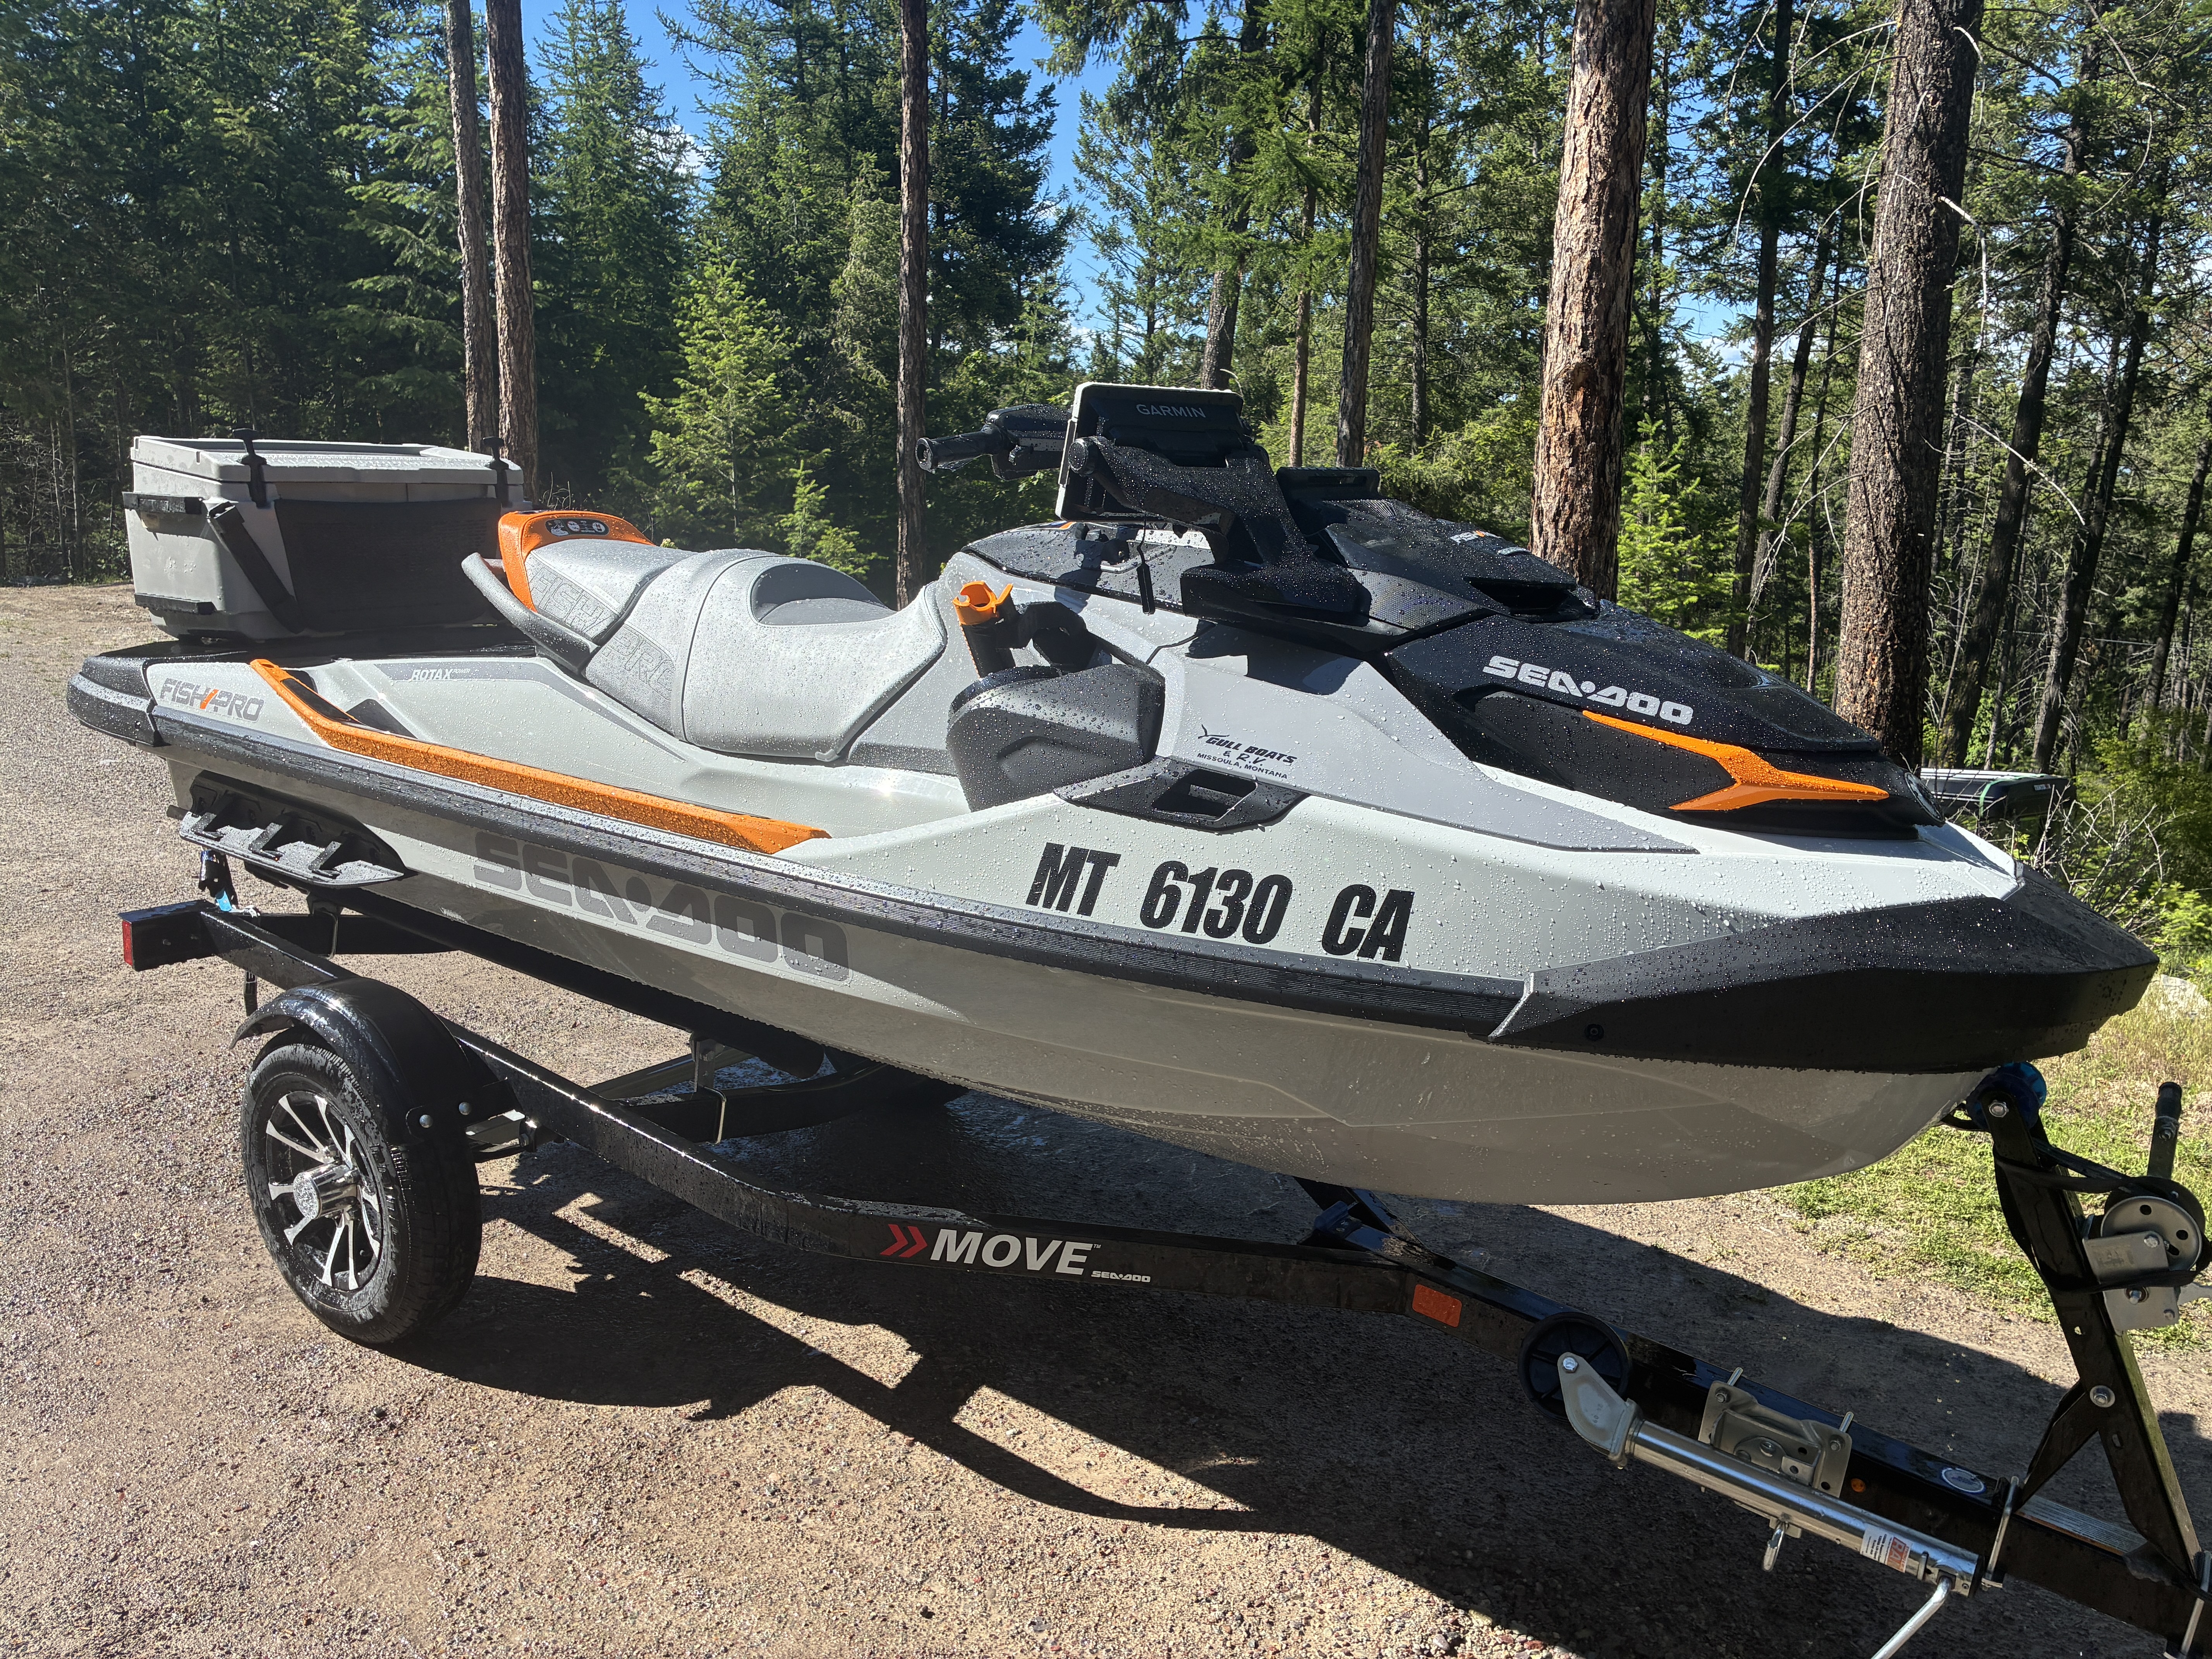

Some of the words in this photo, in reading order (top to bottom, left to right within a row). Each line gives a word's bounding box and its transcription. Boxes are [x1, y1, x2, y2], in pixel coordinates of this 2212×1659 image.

[1136, 404, 1206, 418] GARMIN
[411, 668, 453, 681] ROTAX
[1205, 737, 1242, 750] GULL
[1244, 746, 1297, 764] BOATS
[1223, 751, 1231, 759] &
[1236, 753, 1266, 766] R.V.
[1197, 753, 1242, 769] MISSOULA,
[1244, 764, 1288, 779] MONTANA
[1025, 842, 1121, 917] MT
[1140, 860, 1293, 945] 6130
[1321, 884, 1415, 962] CA
